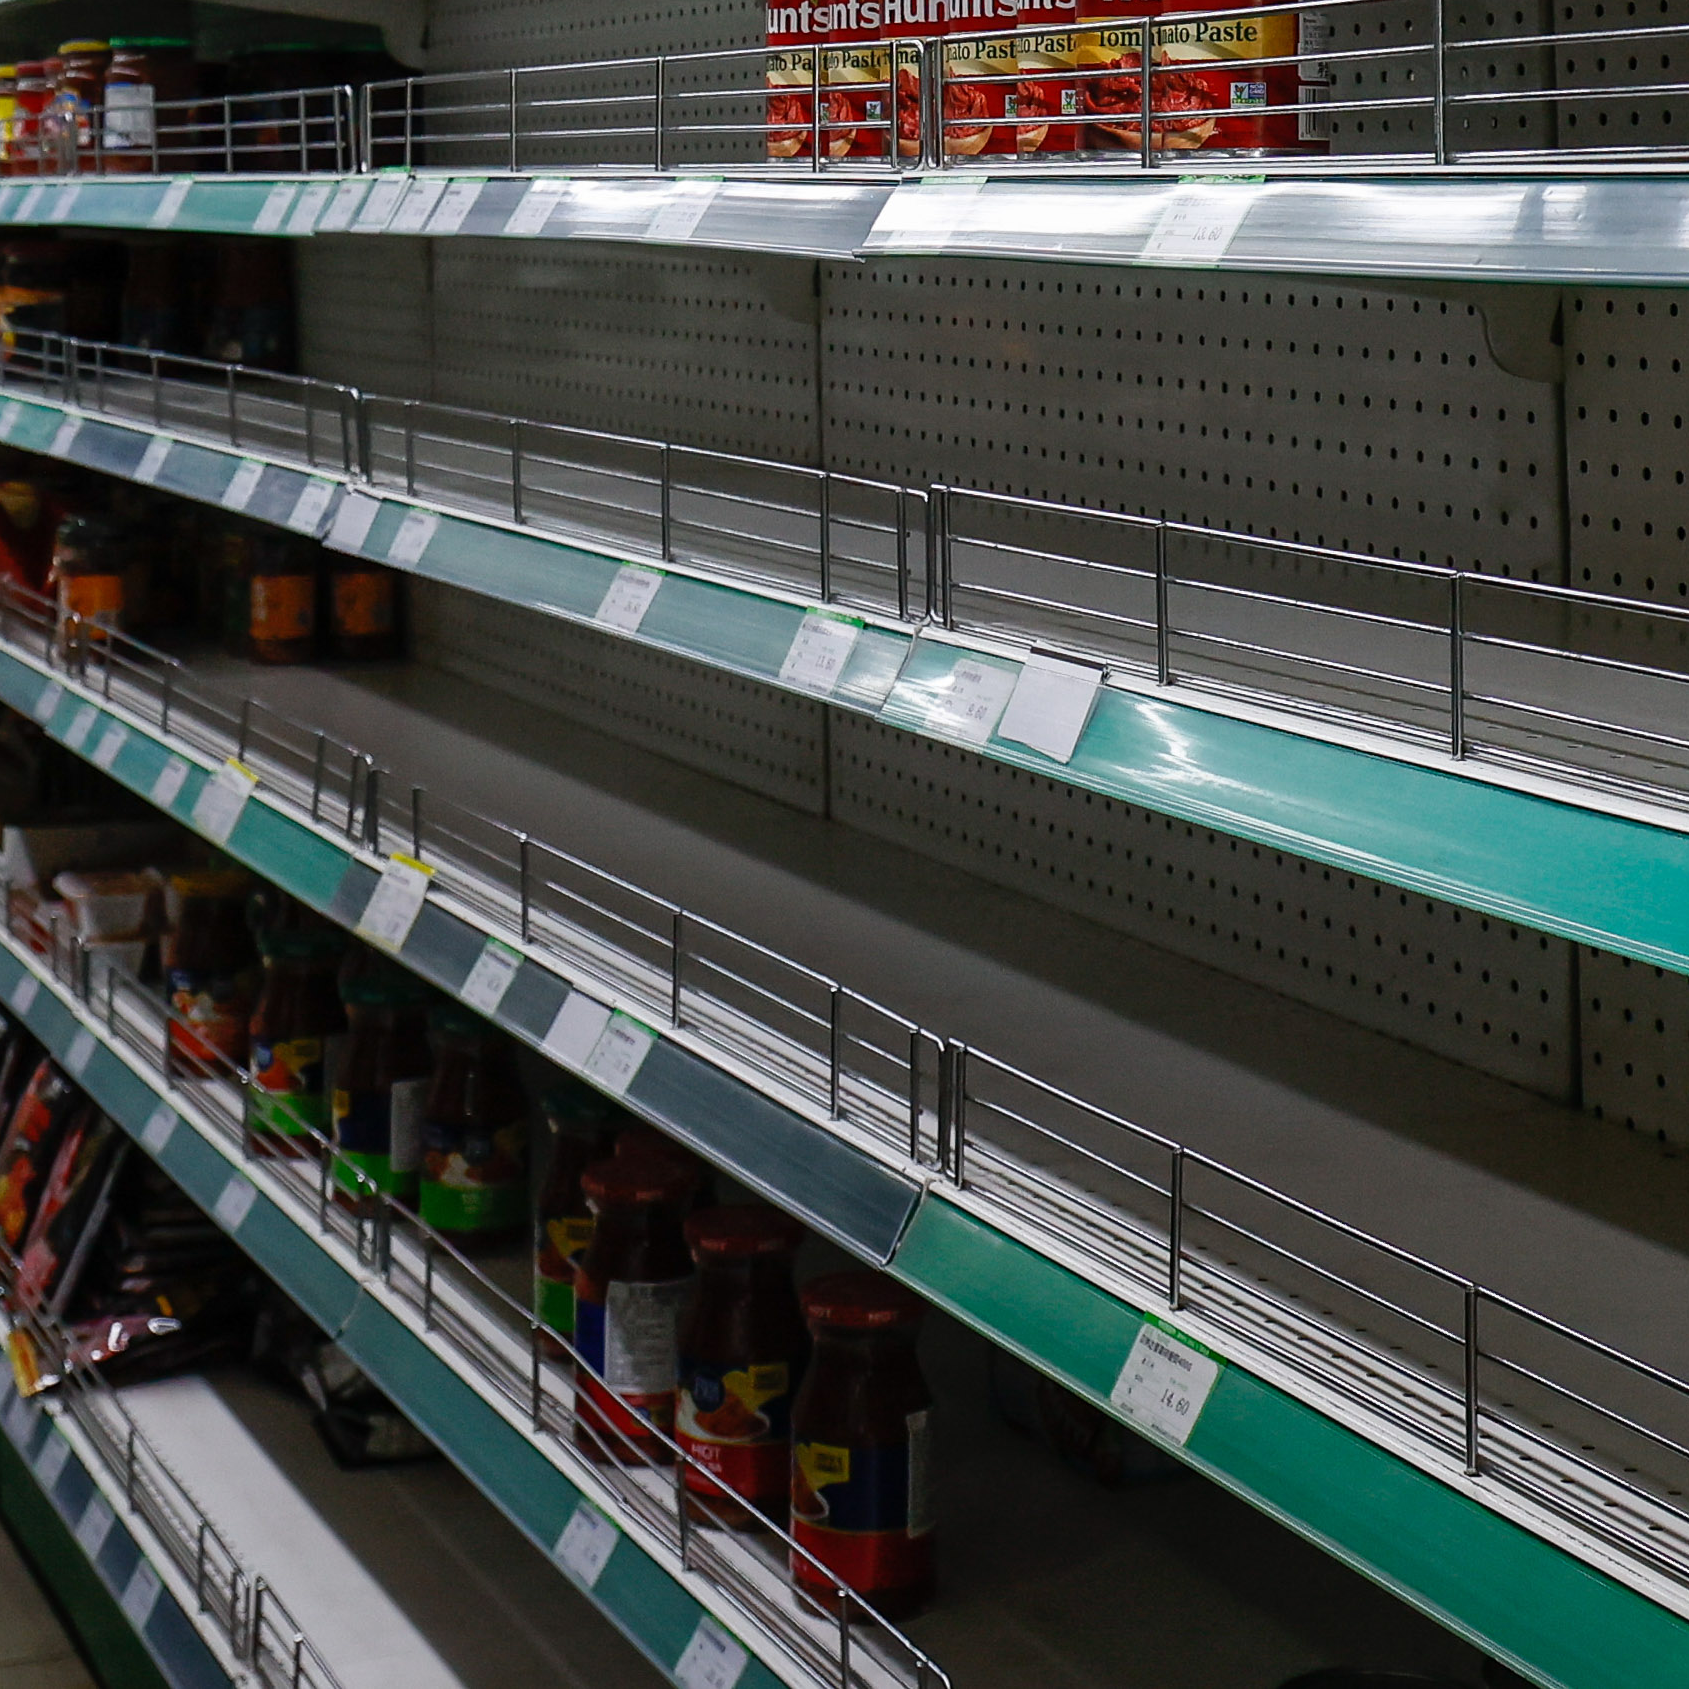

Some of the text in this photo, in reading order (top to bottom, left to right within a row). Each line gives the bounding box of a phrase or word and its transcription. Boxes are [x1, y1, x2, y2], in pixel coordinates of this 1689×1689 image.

[1196, 21, 1258, 43] Paste
[974, 40, 1017, 60] Past
[691, 1443, 722, 1460] HOT
